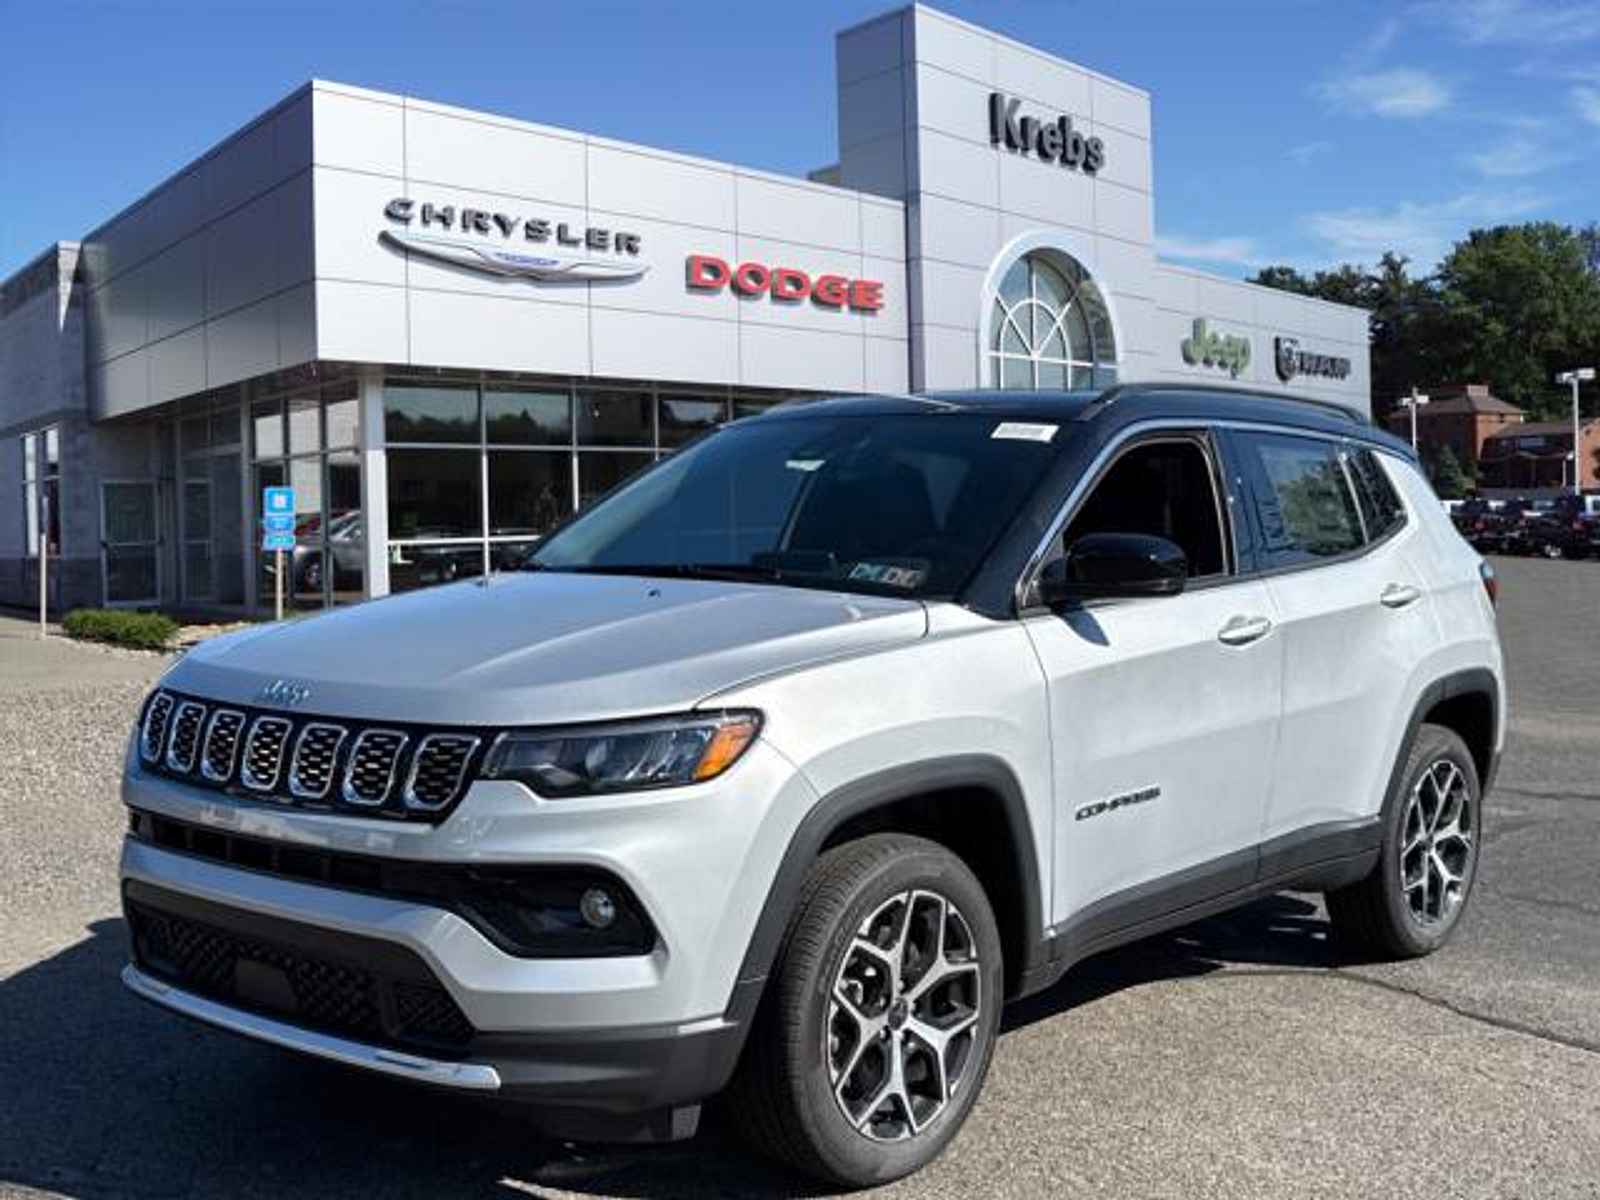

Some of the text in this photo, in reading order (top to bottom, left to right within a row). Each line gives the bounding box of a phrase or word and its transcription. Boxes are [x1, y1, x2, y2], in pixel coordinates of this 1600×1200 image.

[989, 92, 1104, 177] Krebs
[383, 197, 642, 255] CHRYSLER
[686, 255, 883, 315] DODGE
[1181, 318, 1250, 379] Jeep
